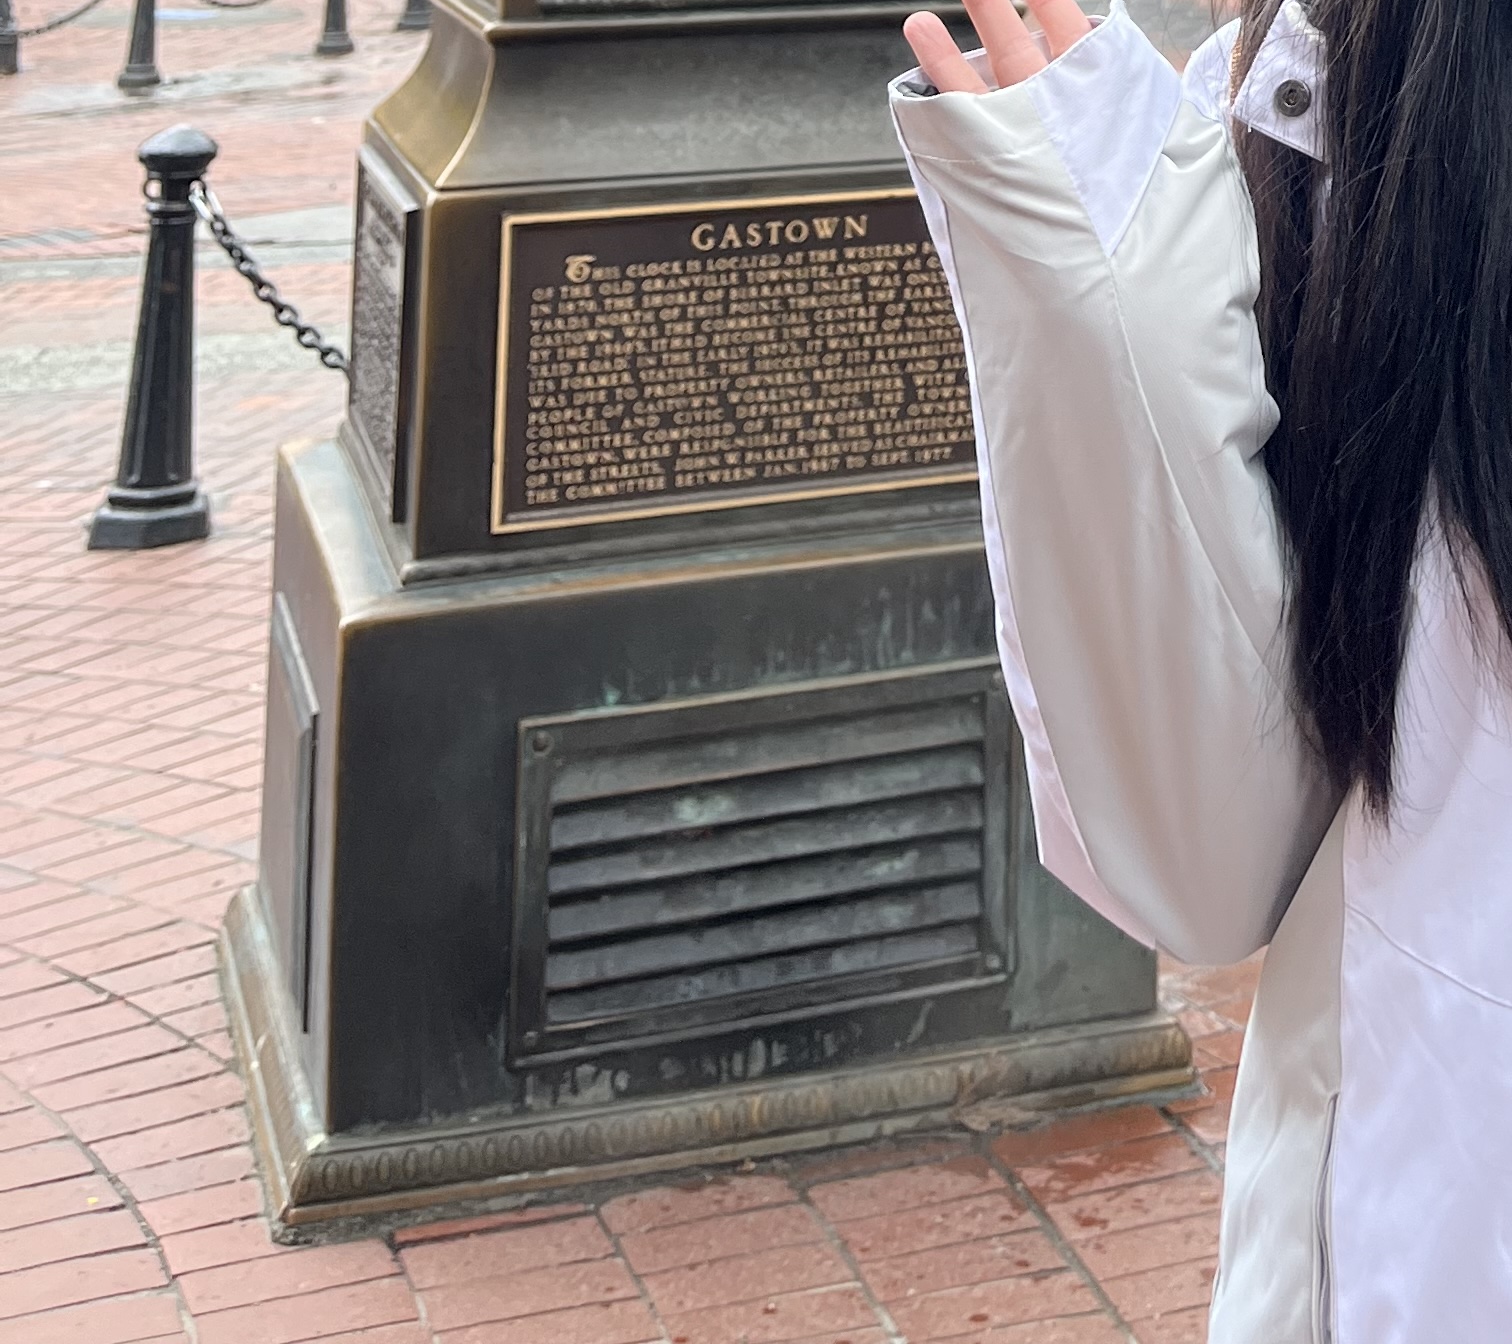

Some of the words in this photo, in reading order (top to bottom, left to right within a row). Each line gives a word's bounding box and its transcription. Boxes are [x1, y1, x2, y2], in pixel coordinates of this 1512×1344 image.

[690, 210, 869, 252] GASTOWN
[531, 286, 554, 302] OF
[558, 283, 592, 299] THE
[598, 279, 635, 296] OLD
[641, 270, 739, 292] GRANVILLE
[835, 257, 898, 276] KNOWN
[902, 255, 922, 270] AS
[625, 260, 683, 278] CLOCK
[808, 247, 837, 263] THE
[842, 241, 917, 260] WESTERN
[530, 302, 552, 317] IN
[603, 295, 634, 311] THE
[702, 287, 725, 302] OF
[867, 272, 901, 288] WAS
[659, 306, 681, 321] OF
[867, 288, 897, 303] THE
[528, 348, 550, 363] BY
[556, 344, 589, 361] THE
[782, 324, 810, 340] THE
[881, 316, 902, 331] OF
[621, 323, 659, 340] WAS
[664, 320, 694, 336] THE
[884, 301, 906, 316] OF
[718, 359, 750, 375] THE
[821, 350, 842, 365] OF
[527, 405, 595, 426] PEOPLE
[600, 402, 624, 418] OF
[911, 369, 956, 387] WITH
[527, 393, 567, 410] WAS
[615, 386, 639, 401] TO
[620, 414, 660, 431] AND
[673, 407, 724, 425] CIVIC
[872, 389, 904, 405] THE
[742, 419, 765, 434] OF
[771, 415, 802, 431] THE
[796, 426, 832, 443] FOR
[836, 422, 867, 439] THE
[524, 486, 559, 505] THE
[674, 465, 756, 489] BETWEEN
[844, 453, 867, 470] TO
[525, 472, 548, 489] OF
[552, 468, 584, 486] THE
